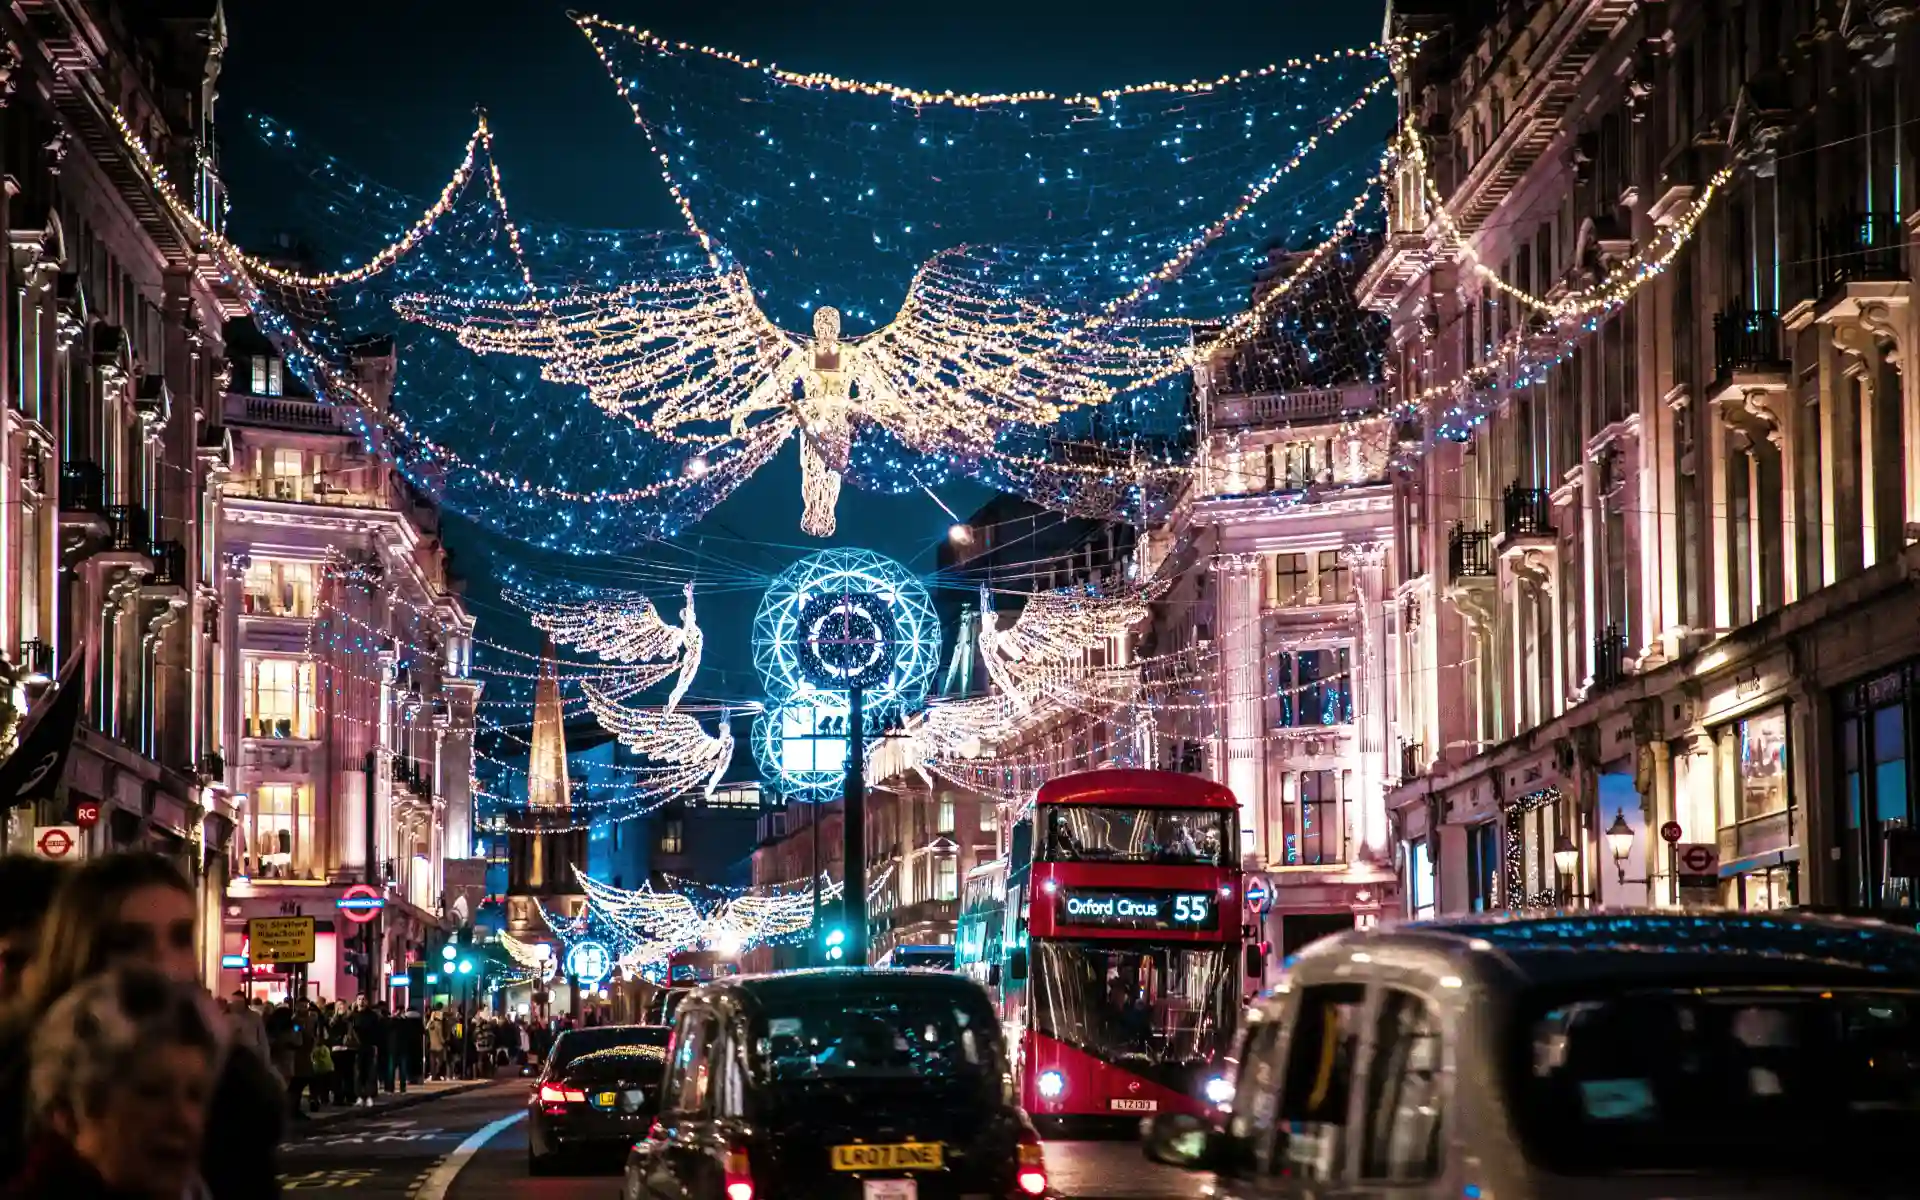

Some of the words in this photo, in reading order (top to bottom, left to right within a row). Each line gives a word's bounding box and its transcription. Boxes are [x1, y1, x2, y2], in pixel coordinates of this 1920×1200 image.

[78, 808, 96, 820] RC
[338, 899, 383, 907] UNDROUND
[1067, 898, 1113, 915] Oxford
[1117, 899, 1158, 916] Circus
[1174, 896, 1207, 921] 55
